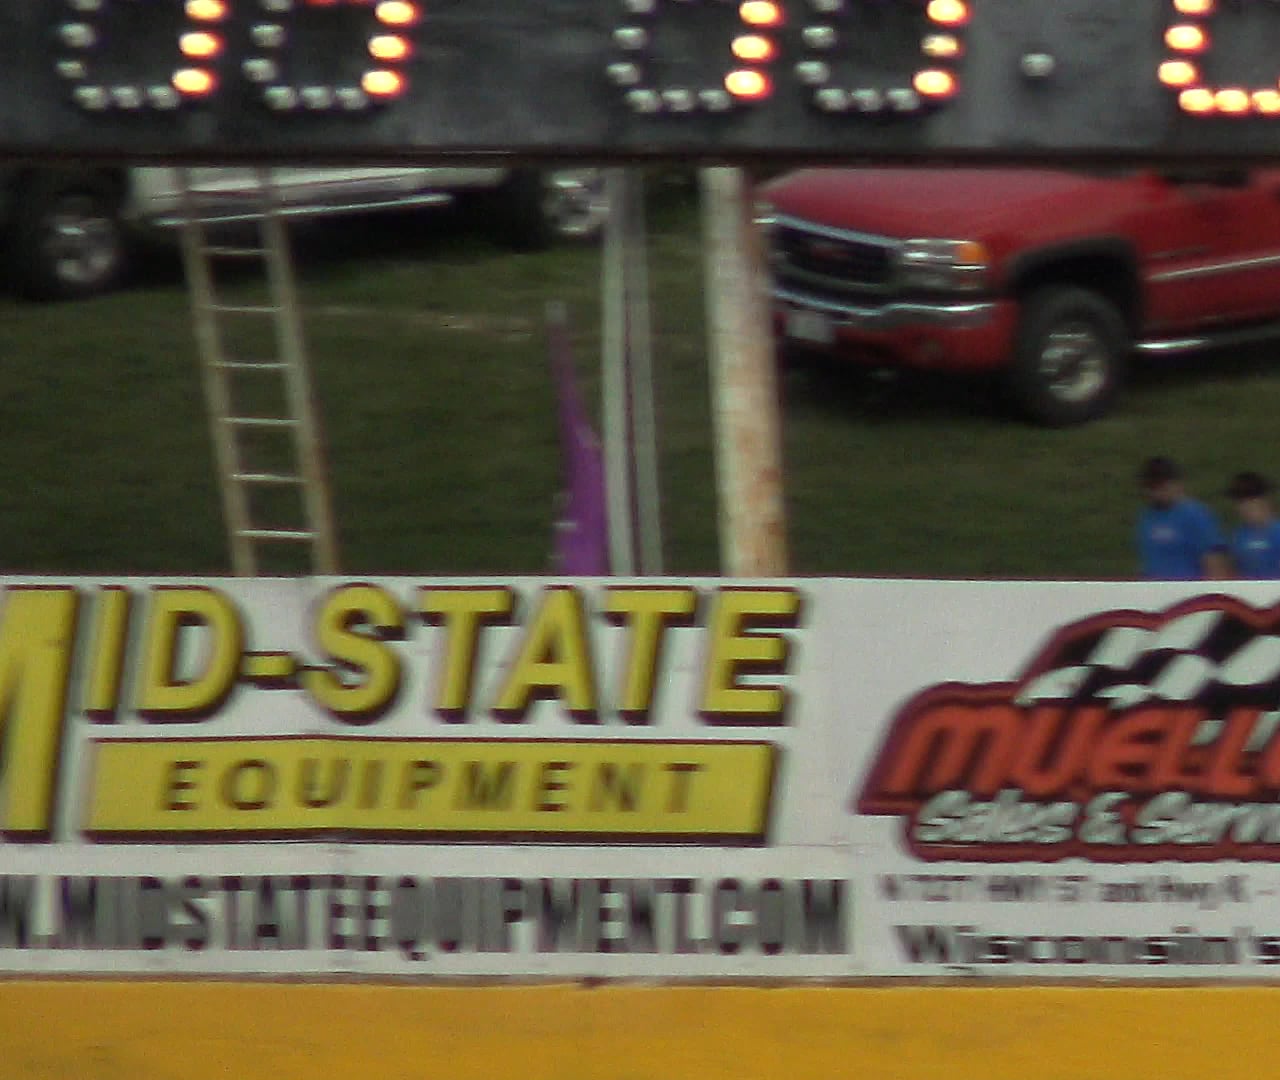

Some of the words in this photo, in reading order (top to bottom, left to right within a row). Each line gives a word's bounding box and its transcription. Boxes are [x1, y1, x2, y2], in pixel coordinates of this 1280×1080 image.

[160, 758, 705, 815] EQUIPMENT
[914, 789, 1079, 845] Sales
[1079, 789, 1131, 846] &
